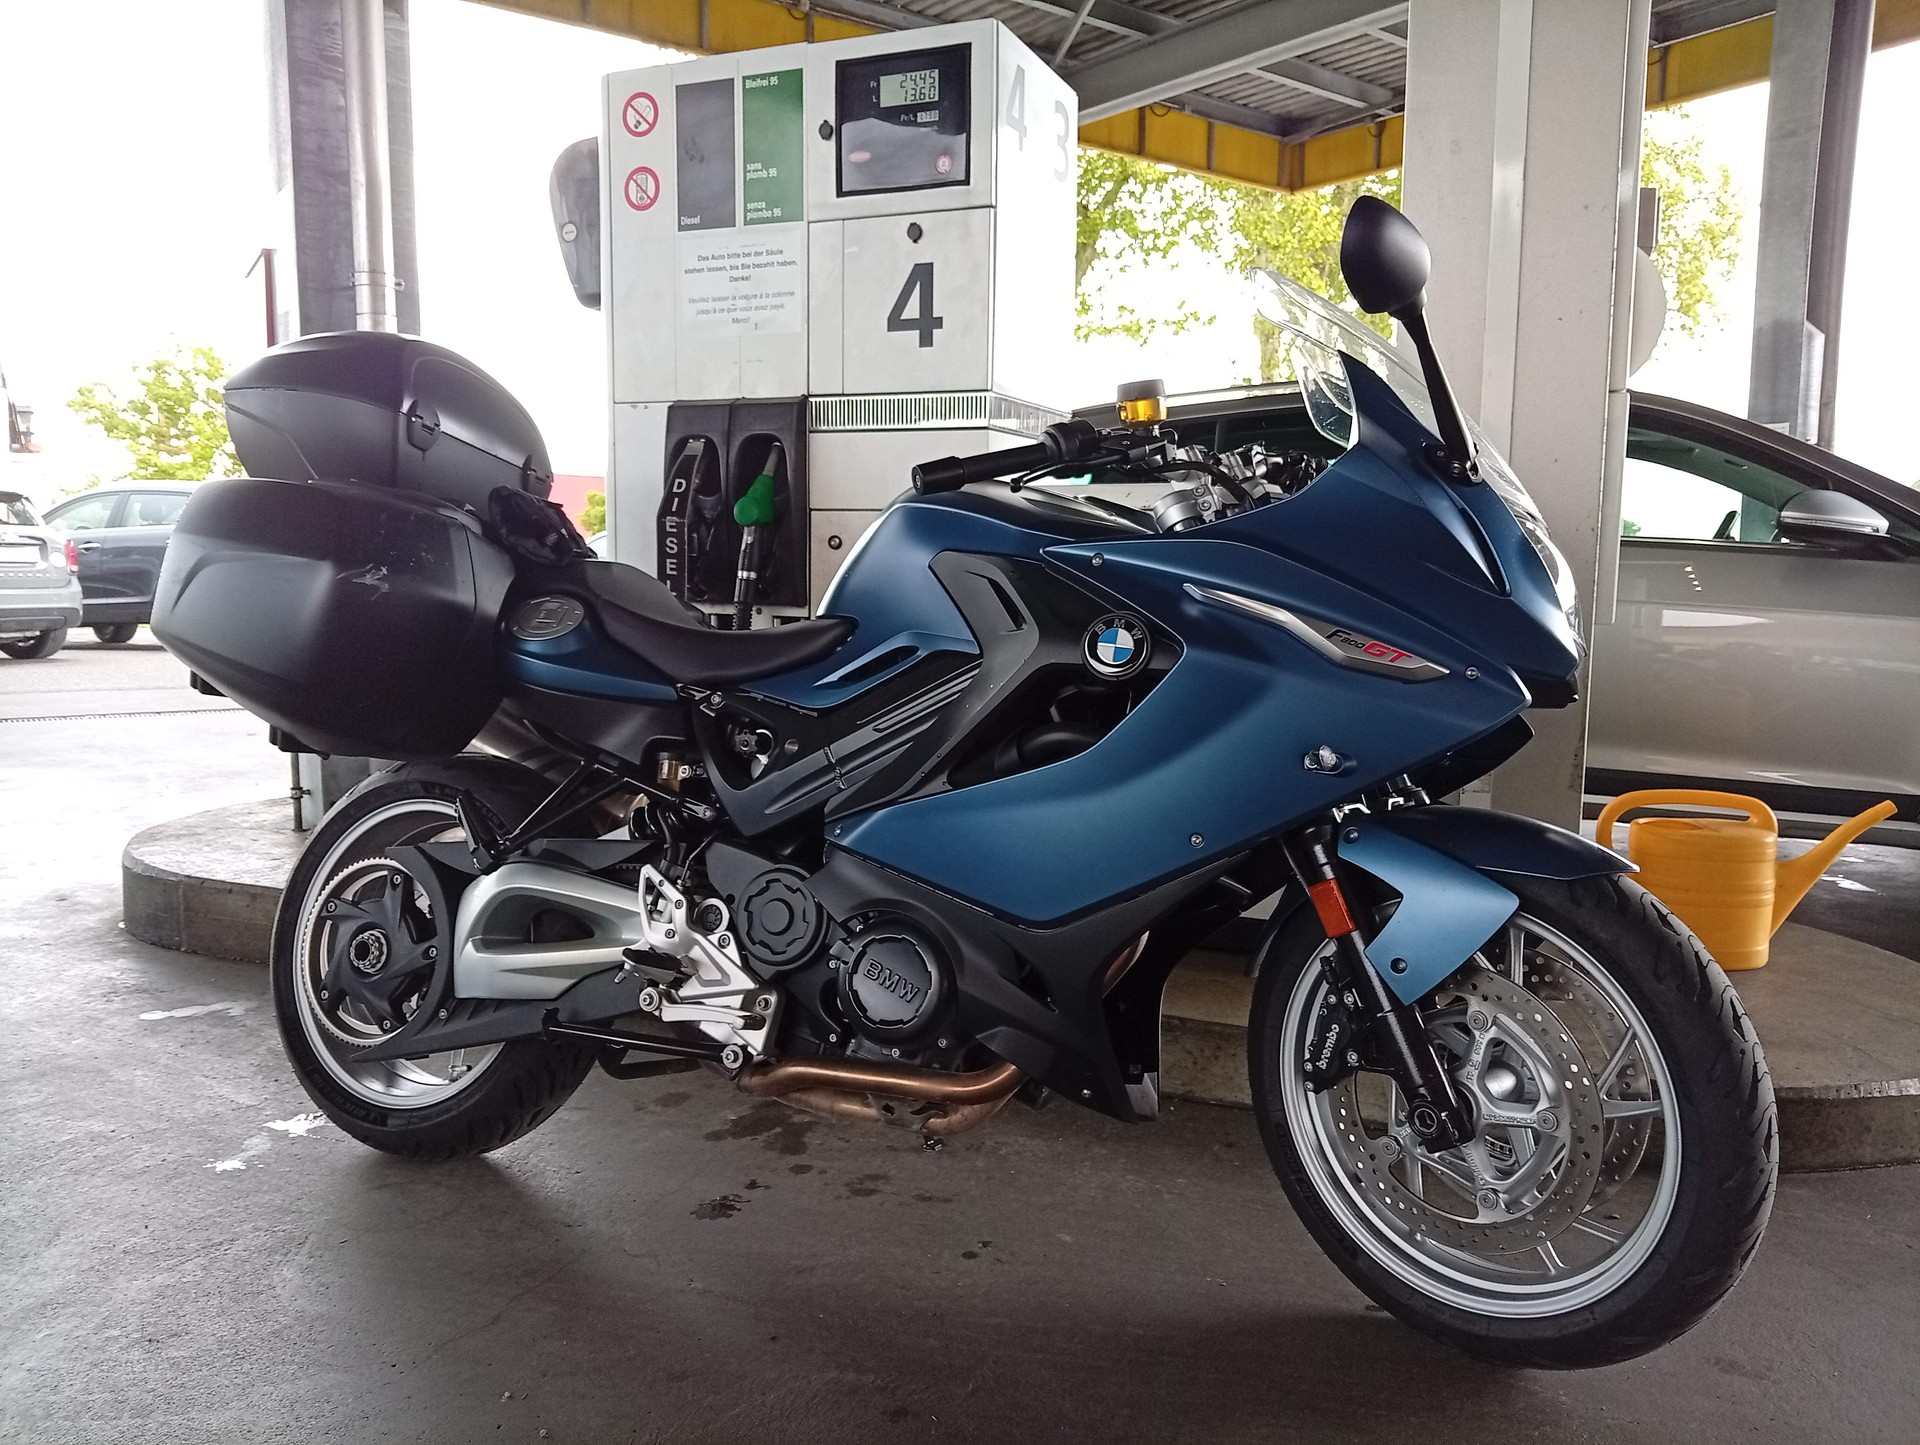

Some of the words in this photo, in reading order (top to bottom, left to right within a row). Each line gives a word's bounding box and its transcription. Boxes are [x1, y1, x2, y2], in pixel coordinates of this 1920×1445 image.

[745, 77, 769, 89] Bleifrei
[769, 76, 779, 86] 95
[900, 70, 936, 88] 24.45
[904, 85, 936, 102] 13.60
[1006, 64, 1027, 152] 4
[1055, 100, 1070, 183] 3
[746, 162, 762, 171] sans
[746, 169, 768, 181] plomb
[768, 168, 777, 178] 95
[746, 201, 766, 210] senza
[680, 215, 701, 226] Diesel
[746, 209, 772, 221] piombo
[772, 207, 782, 218] 95
[727, 252, 741, 260] bitte
[752, 261, 775, 269] bezahlt
[776, 259, 798, 267] haben.
[729, 275, 752, 283] Danke!
[887, 262, 943, 348] 4
[1095, 618, 1143, 640] BMW
[863, 958, 920, 1004] BMW
[1315, 1024, 1340, 1070] brembo
